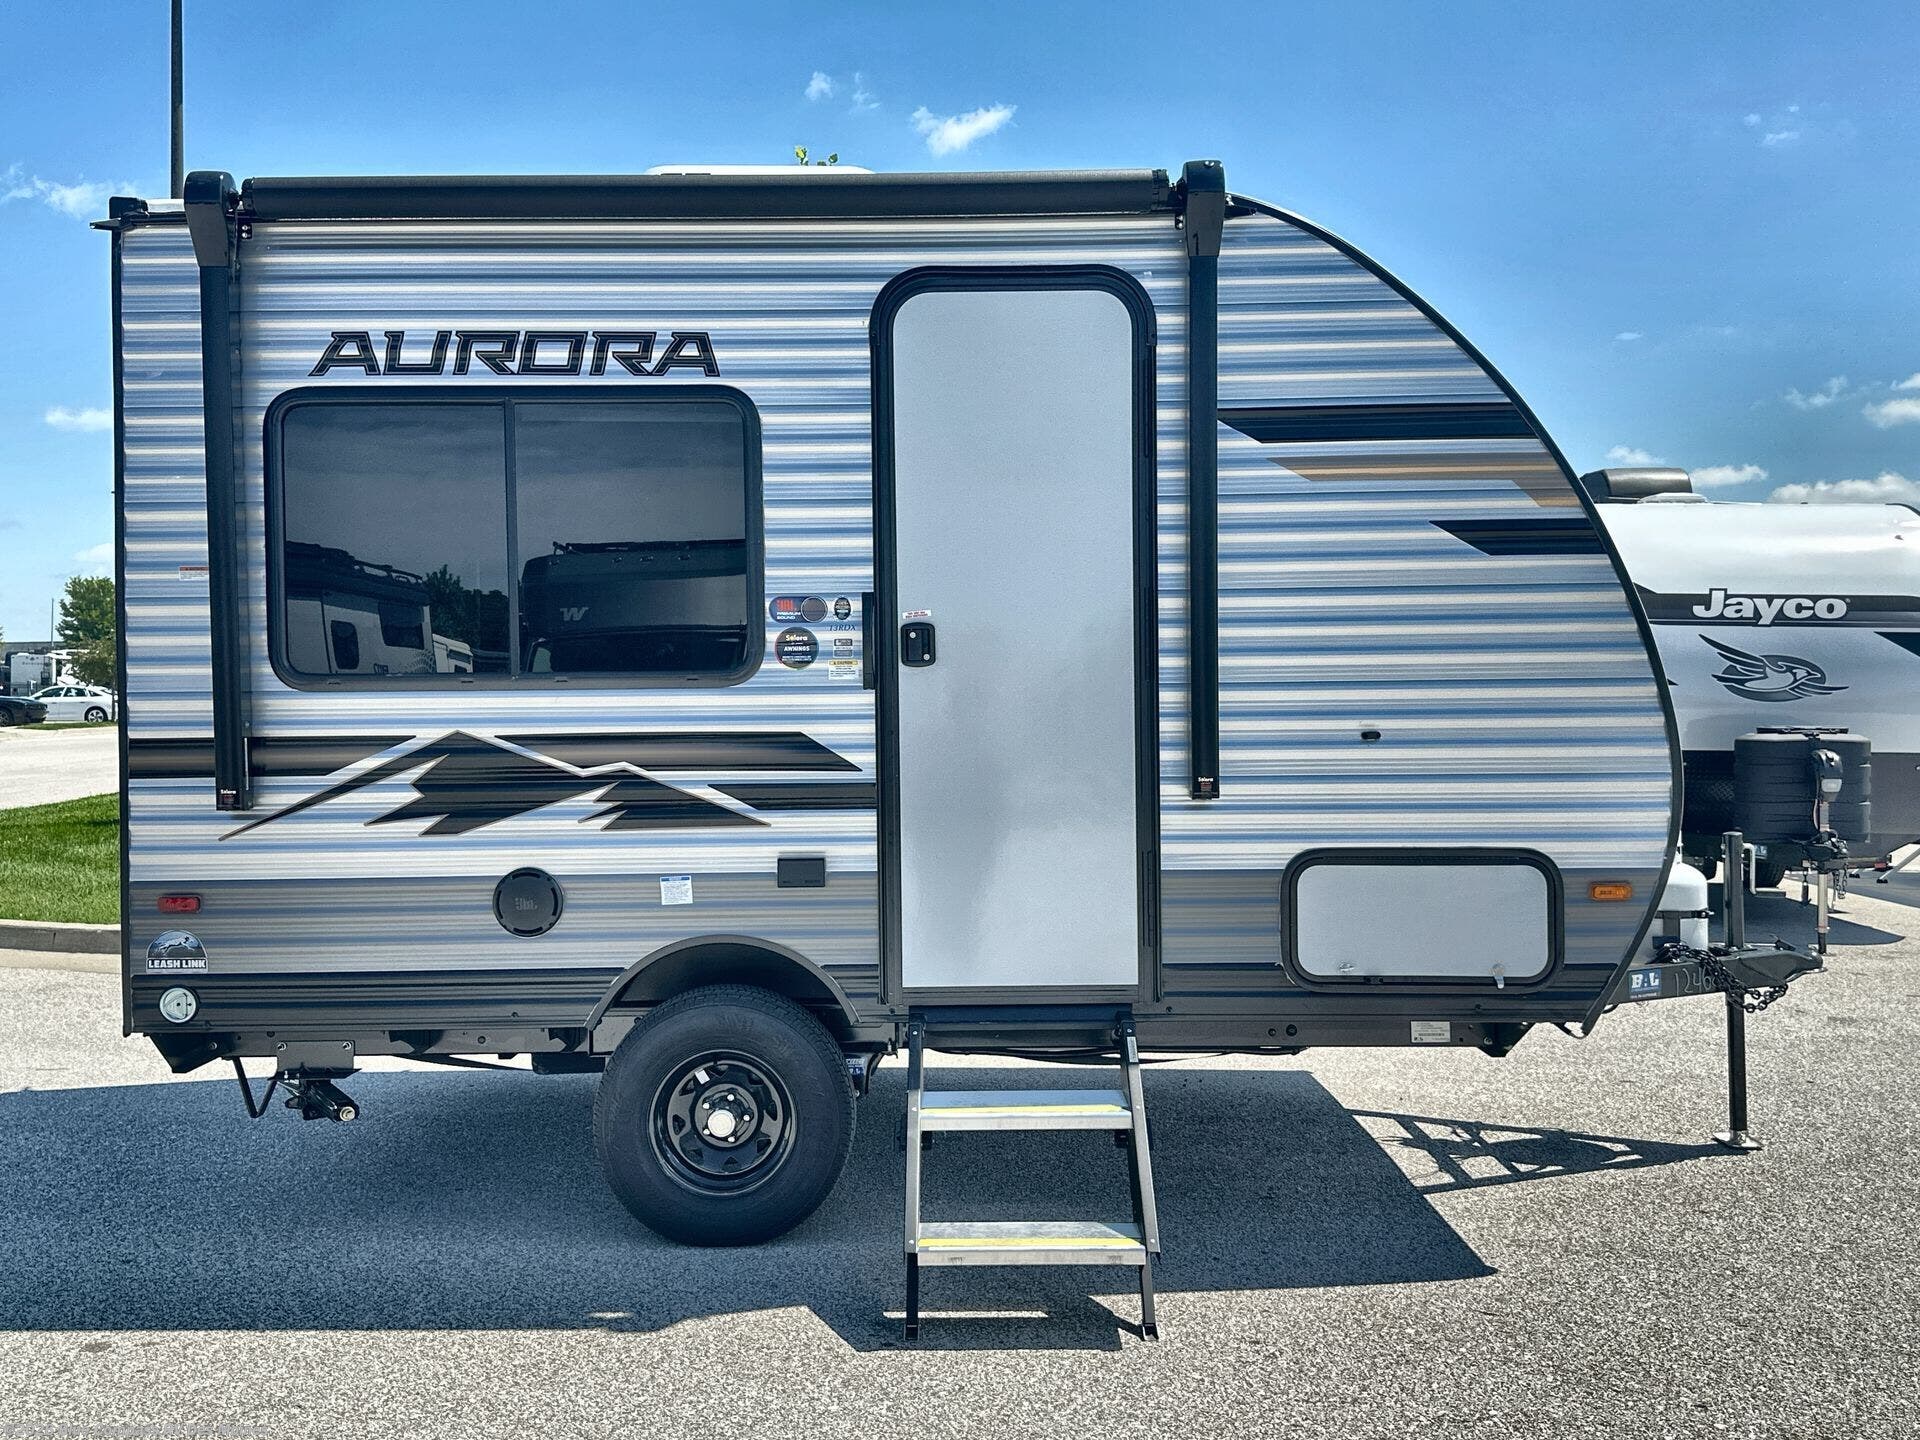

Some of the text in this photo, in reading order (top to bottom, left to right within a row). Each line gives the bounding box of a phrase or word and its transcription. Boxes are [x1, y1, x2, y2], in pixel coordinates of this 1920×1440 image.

[308, 331, 721, 377] AURORA
[1692, 589, 1848, 625] Jayco
[148, 959, 206, 969] LEASH LINK
